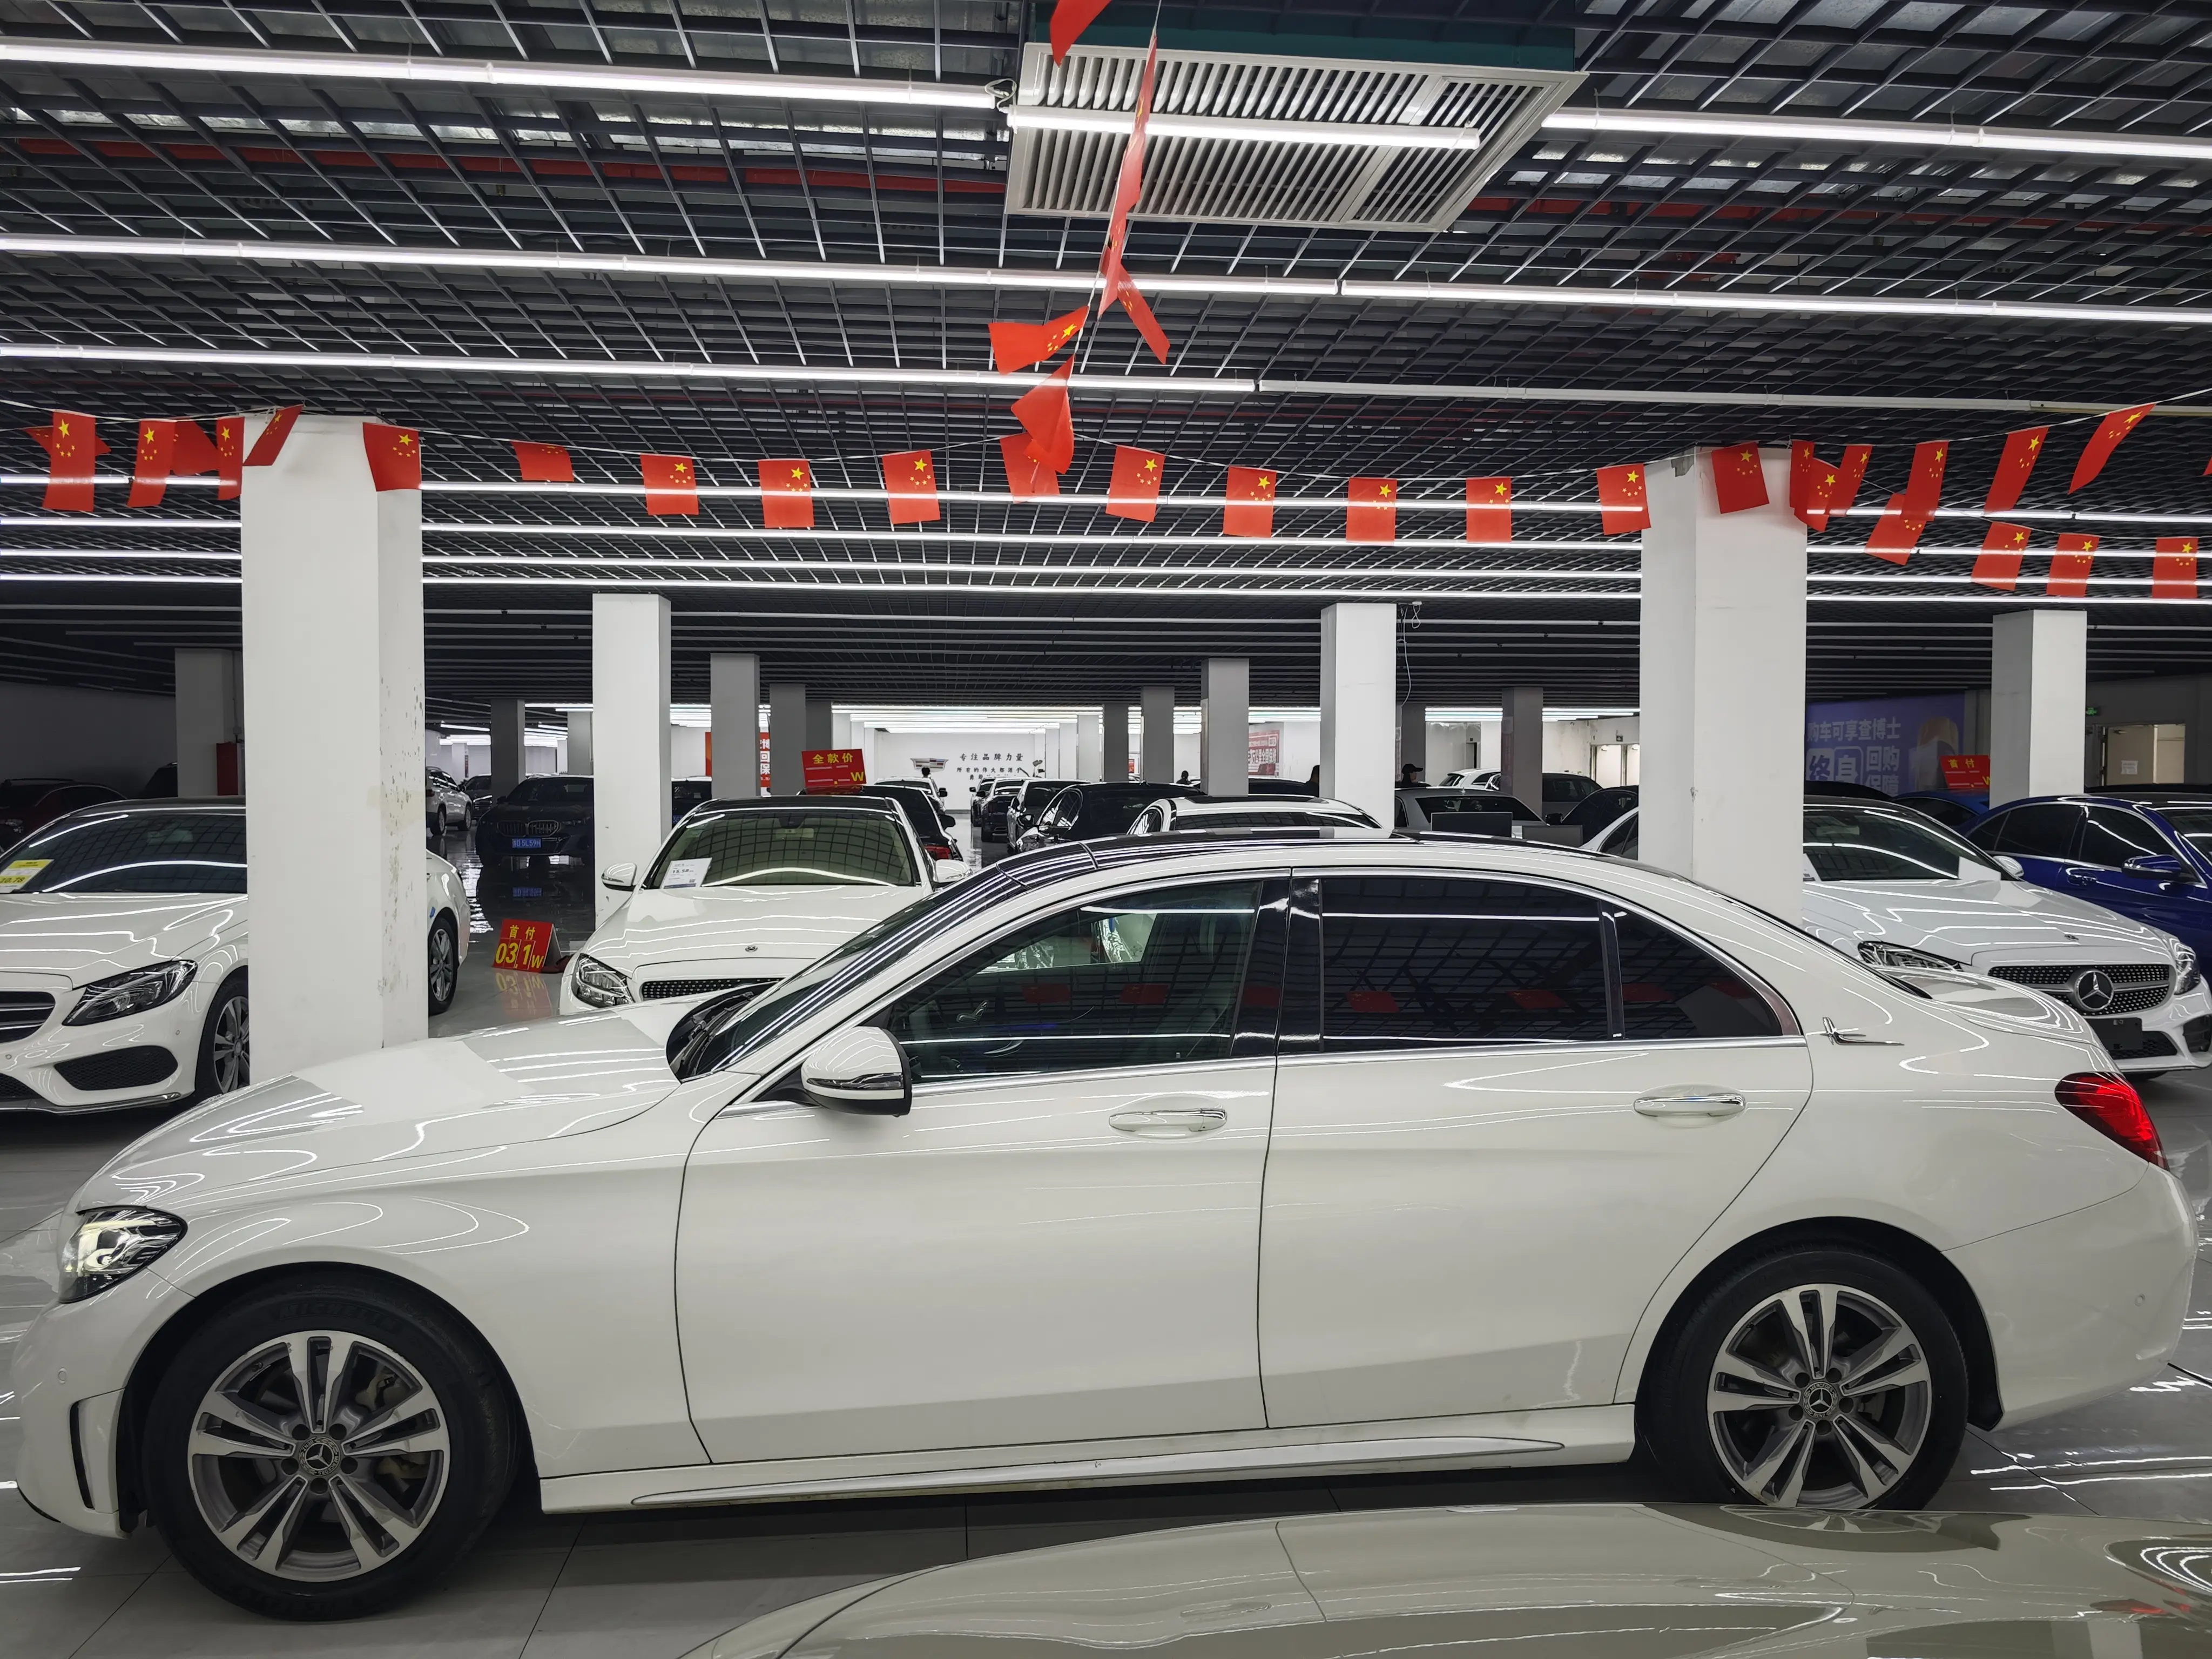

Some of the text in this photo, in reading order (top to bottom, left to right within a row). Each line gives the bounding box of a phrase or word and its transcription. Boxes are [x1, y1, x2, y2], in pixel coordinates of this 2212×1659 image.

[1807, 716, 1901, 742] 购车可享查博士
[813, 753, 853, 764] 全款价
[960, 753, 1023, 761] 专注品牌力量
[1866, 746, 1900, 772] 回购
[1948, 758, 1974, 769] 首付
[509, 925, 536, 940] 首付
[1810, 1383, 1833, 1392] MERCEDES
[318, 1455, 339, 1475] MERCEDES
